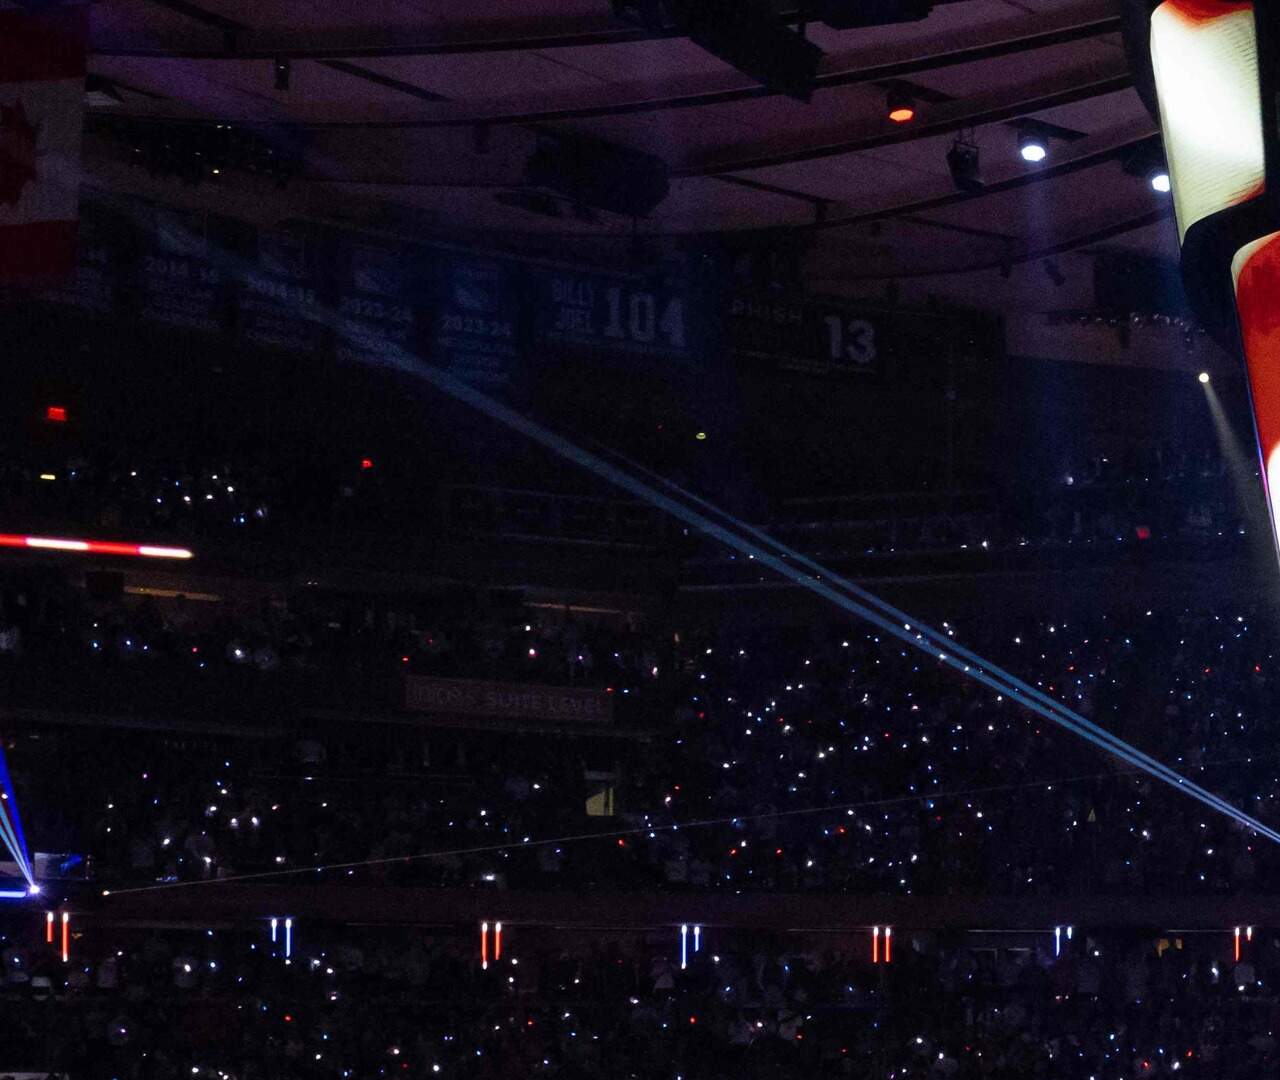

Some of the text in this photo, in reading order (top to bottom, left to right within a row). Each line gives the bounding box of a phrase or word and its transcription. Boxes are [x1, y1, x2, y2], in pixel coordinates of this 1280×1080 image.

[603, 287, 687, 347] 104
[731, 301, 803, 323] PHISH
[824, 315, 876, 363] 13
